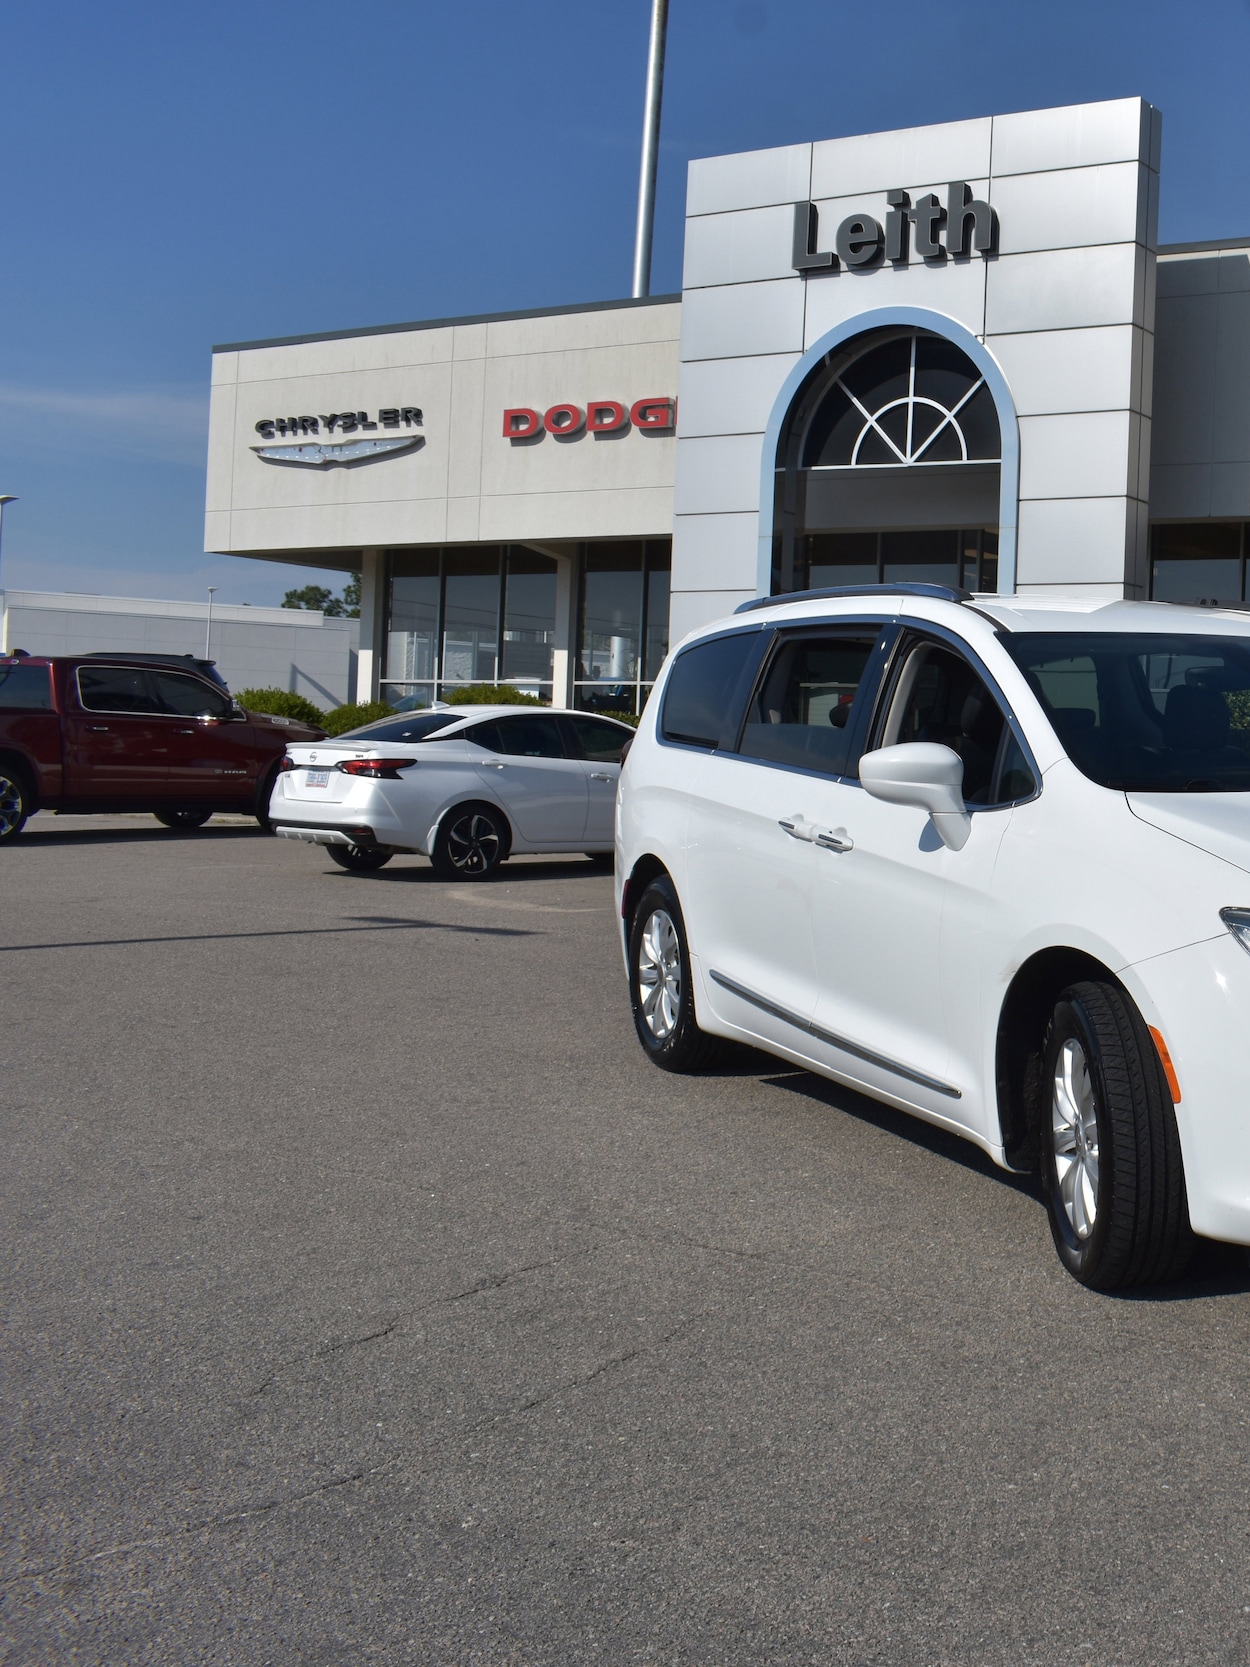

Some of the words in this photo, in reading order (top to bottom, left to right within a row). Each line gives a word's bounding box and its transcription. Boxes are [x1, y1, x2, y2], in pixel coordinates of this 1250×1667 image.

[792, 182, 995, 270] Leith
[255, 407, 424, 437] CHRYSLER
[503, 396, 678, 438] DODG
